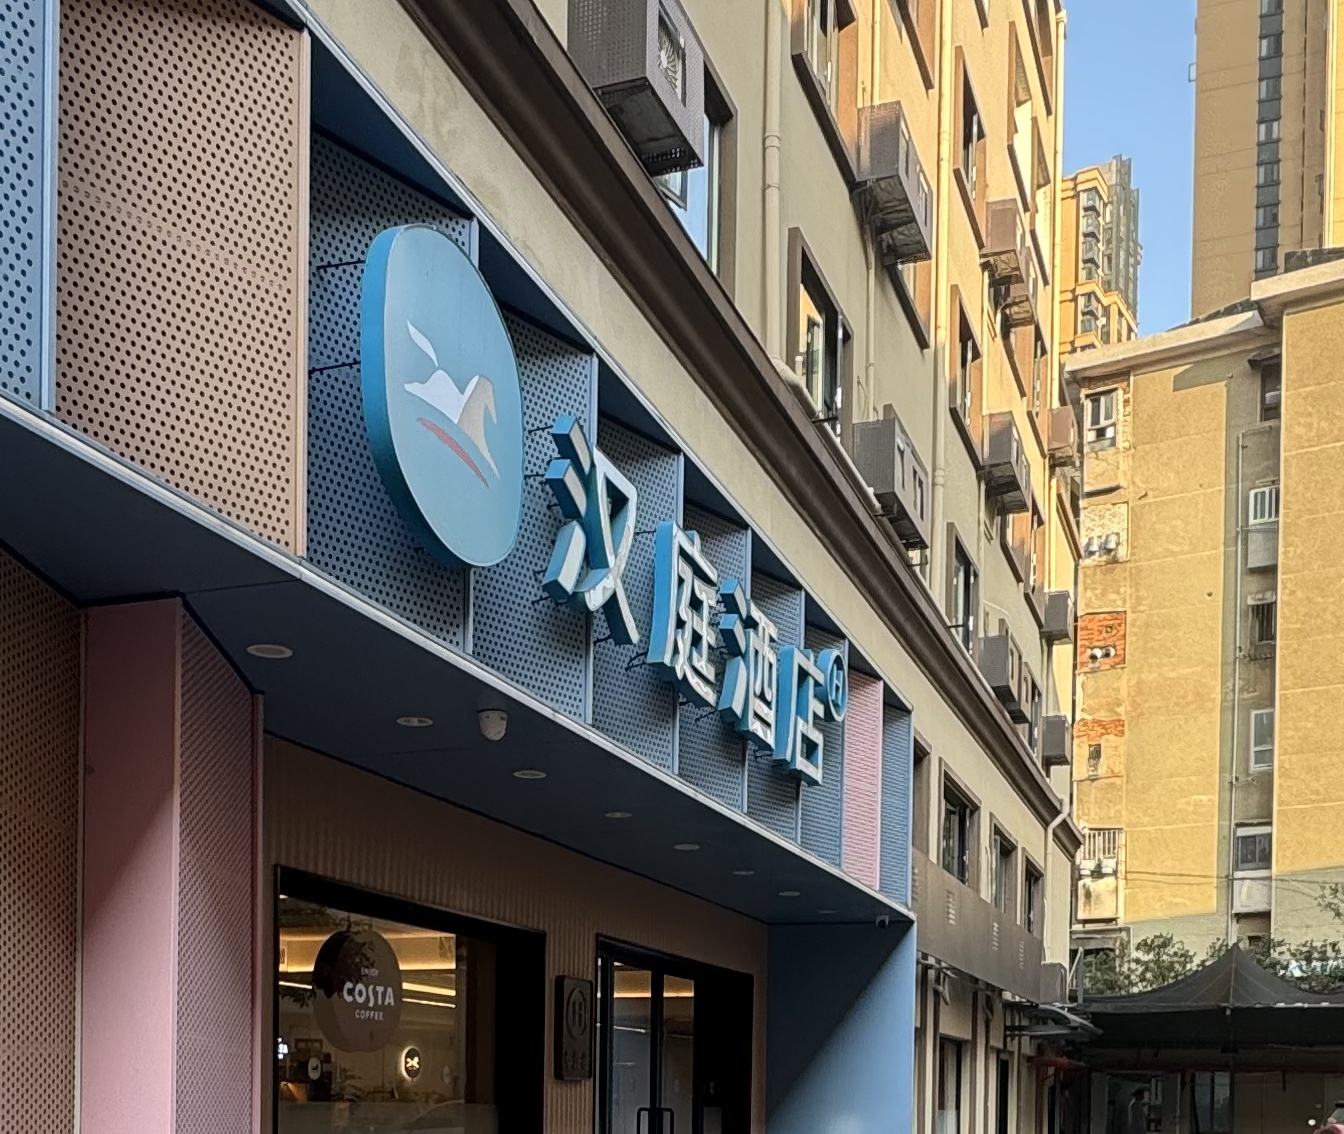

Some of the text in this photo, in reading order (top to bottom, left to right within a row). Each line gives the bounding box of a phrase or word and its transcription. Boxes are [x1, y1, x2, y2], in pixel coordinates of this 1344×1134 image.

[542, 415, 823, 787] 汉庭酒店
[343, 981, 394, 1007] COSTA
[355, 1009, 384, 1021] COFFEE
